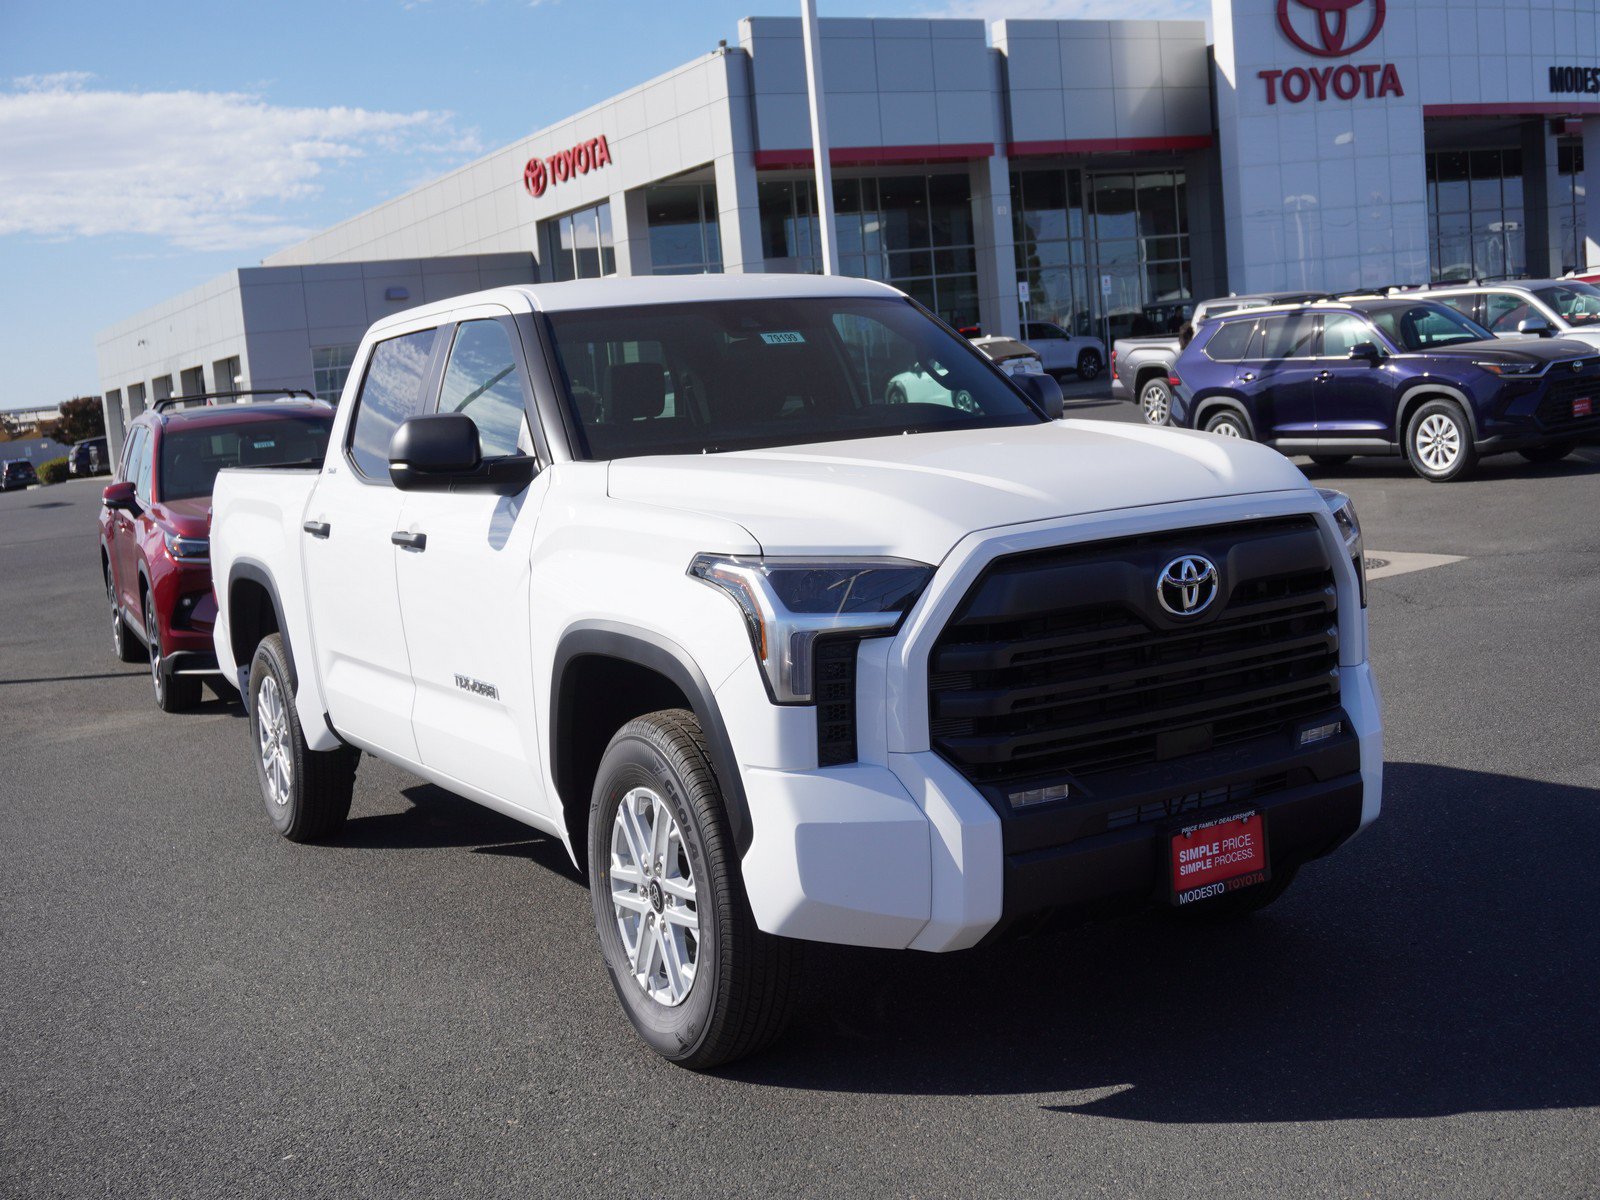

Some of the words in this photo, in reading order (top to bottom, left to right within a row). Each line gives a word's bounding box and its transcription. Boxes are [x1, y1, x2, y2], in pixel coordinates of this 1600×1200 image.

[1257, 63, 1405, 105] TOYOTA
[545, 134, 612, 187] TOYOTA
[1181, 825, 1198, 834] PRICE
[1198, 819, 1218, 830] FAMILY
[1218, 810, 1256, 824] DEALERSHIPS
[1179, 842, 1220, 863] SIMPLE
[1222, 834, 1254, 852] PRICE.
[1180, 859, 1212, 876] SIMPLE
[1214, 848, 1256, 867] PROCESS.
[1179, 882, 1225, 905] MODESTO
[1227, 873, 1265, 890] TOYOTA
